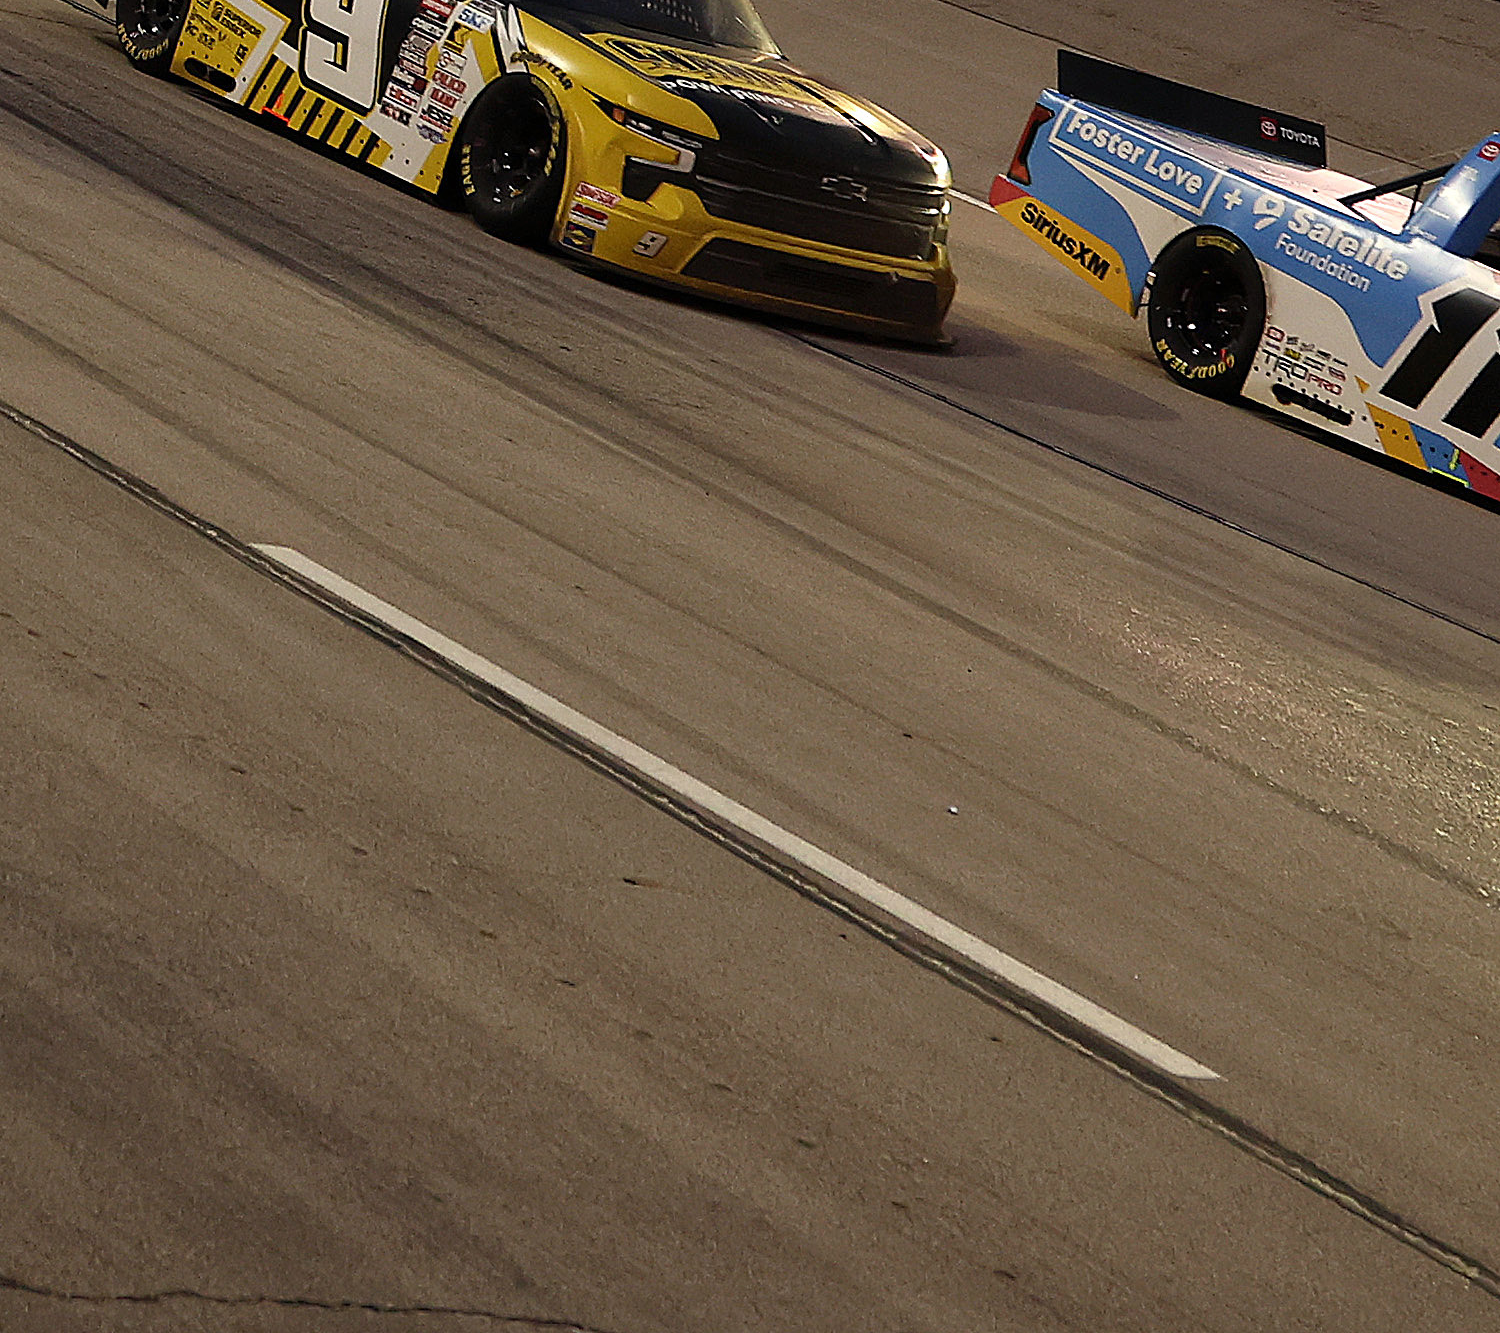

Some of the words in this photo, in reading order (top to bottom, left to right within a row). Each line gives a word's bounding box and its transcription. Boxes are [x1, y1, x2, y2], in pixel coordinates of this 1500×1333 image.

[1066, 109, 1145, 165] Foster
[1144, 149, 1204, 195] Love
[1279, 127, 1321, 148] TOYOTA
[461, 143, 476, 197] EAGLE
[1020, 201, 1112, 282] SiriusXM
[1274, 232, 1372, 293] Foundation
[1287, 206, 1411, 281] Safelite
[1156, 338, 1236, 380] GOODYEAR
[1307, 371, 1343, 396] PRO
